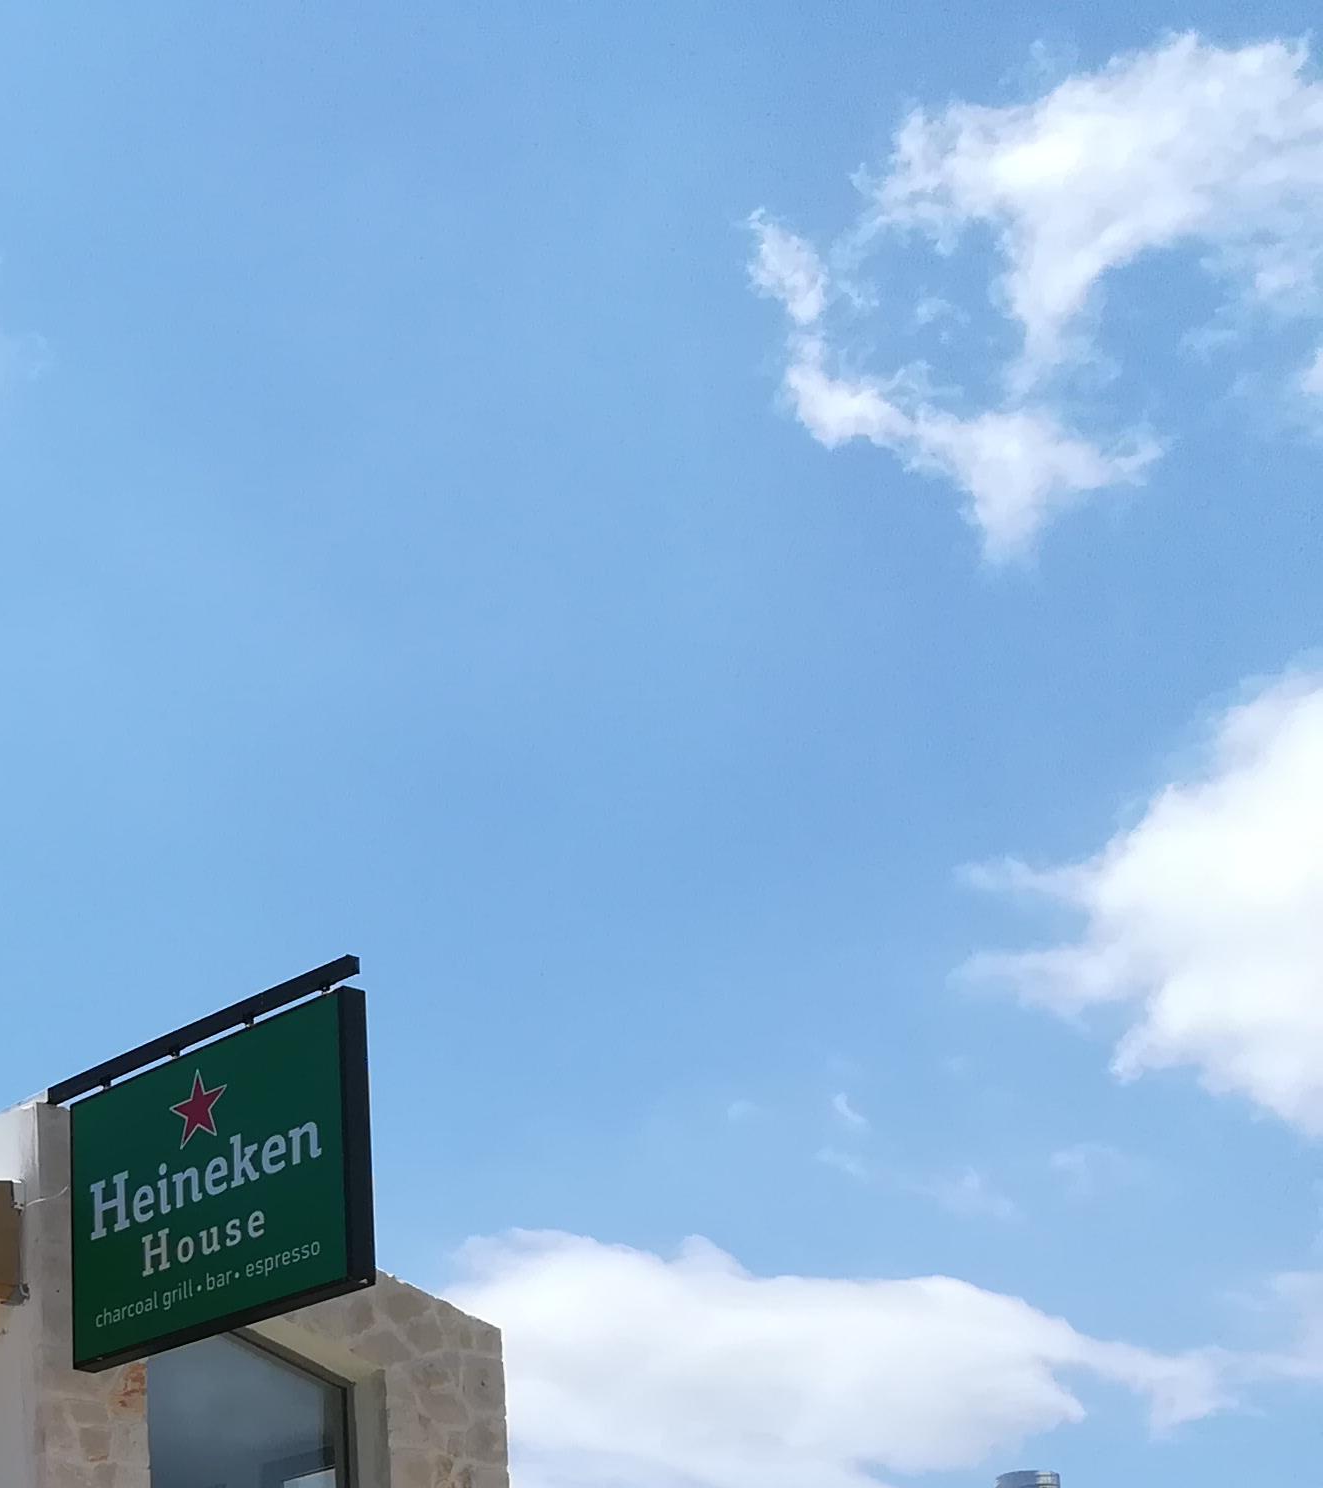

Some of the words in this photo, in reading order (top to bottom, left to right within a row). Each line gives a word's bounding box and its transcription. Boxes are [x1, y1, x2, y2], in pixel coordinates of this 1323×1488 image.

[90, 1120, 322, 1241] Heineken
[95, 1291, 158, 1328] charcoal
[163, 1279, 193, 1311] grill
[206, 1271, 232, 1291] bar
[245, 1240, 321, 1278] espresso
[142, 1209, 265, 1277] House
